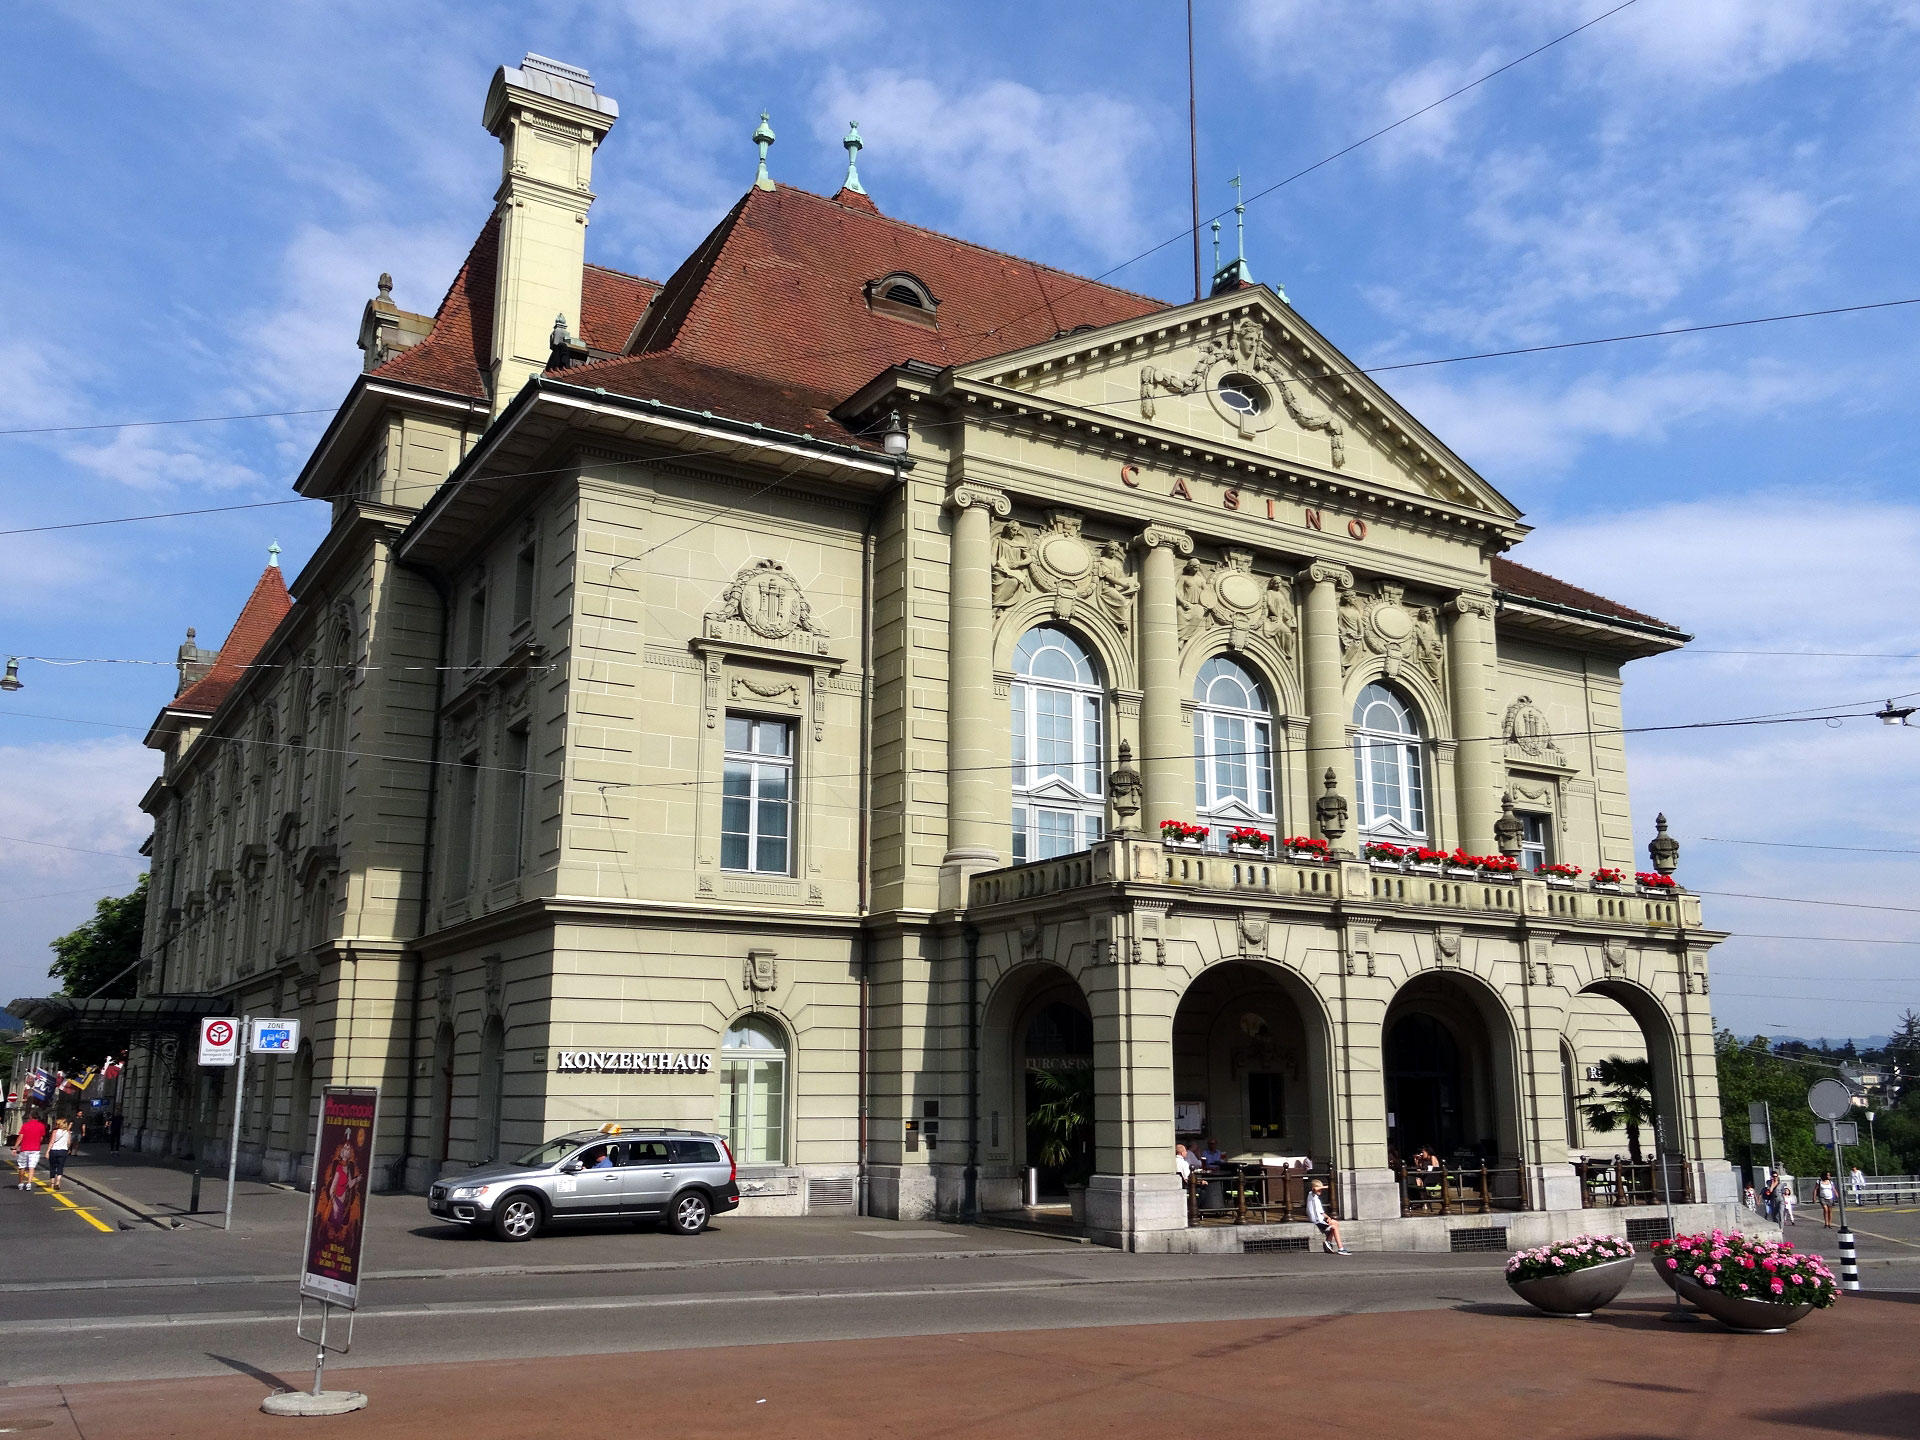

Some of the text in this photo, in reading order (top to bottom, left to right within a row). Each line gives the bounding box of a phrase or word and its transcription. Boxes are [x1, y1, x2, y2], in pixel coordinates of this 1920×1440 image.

[1121, 463, 1367, 541] CASINO
[558, 1051, 713, 1071] KONZERTHAUS
[1025, 1057, 1093, 1069] TURCASIN
